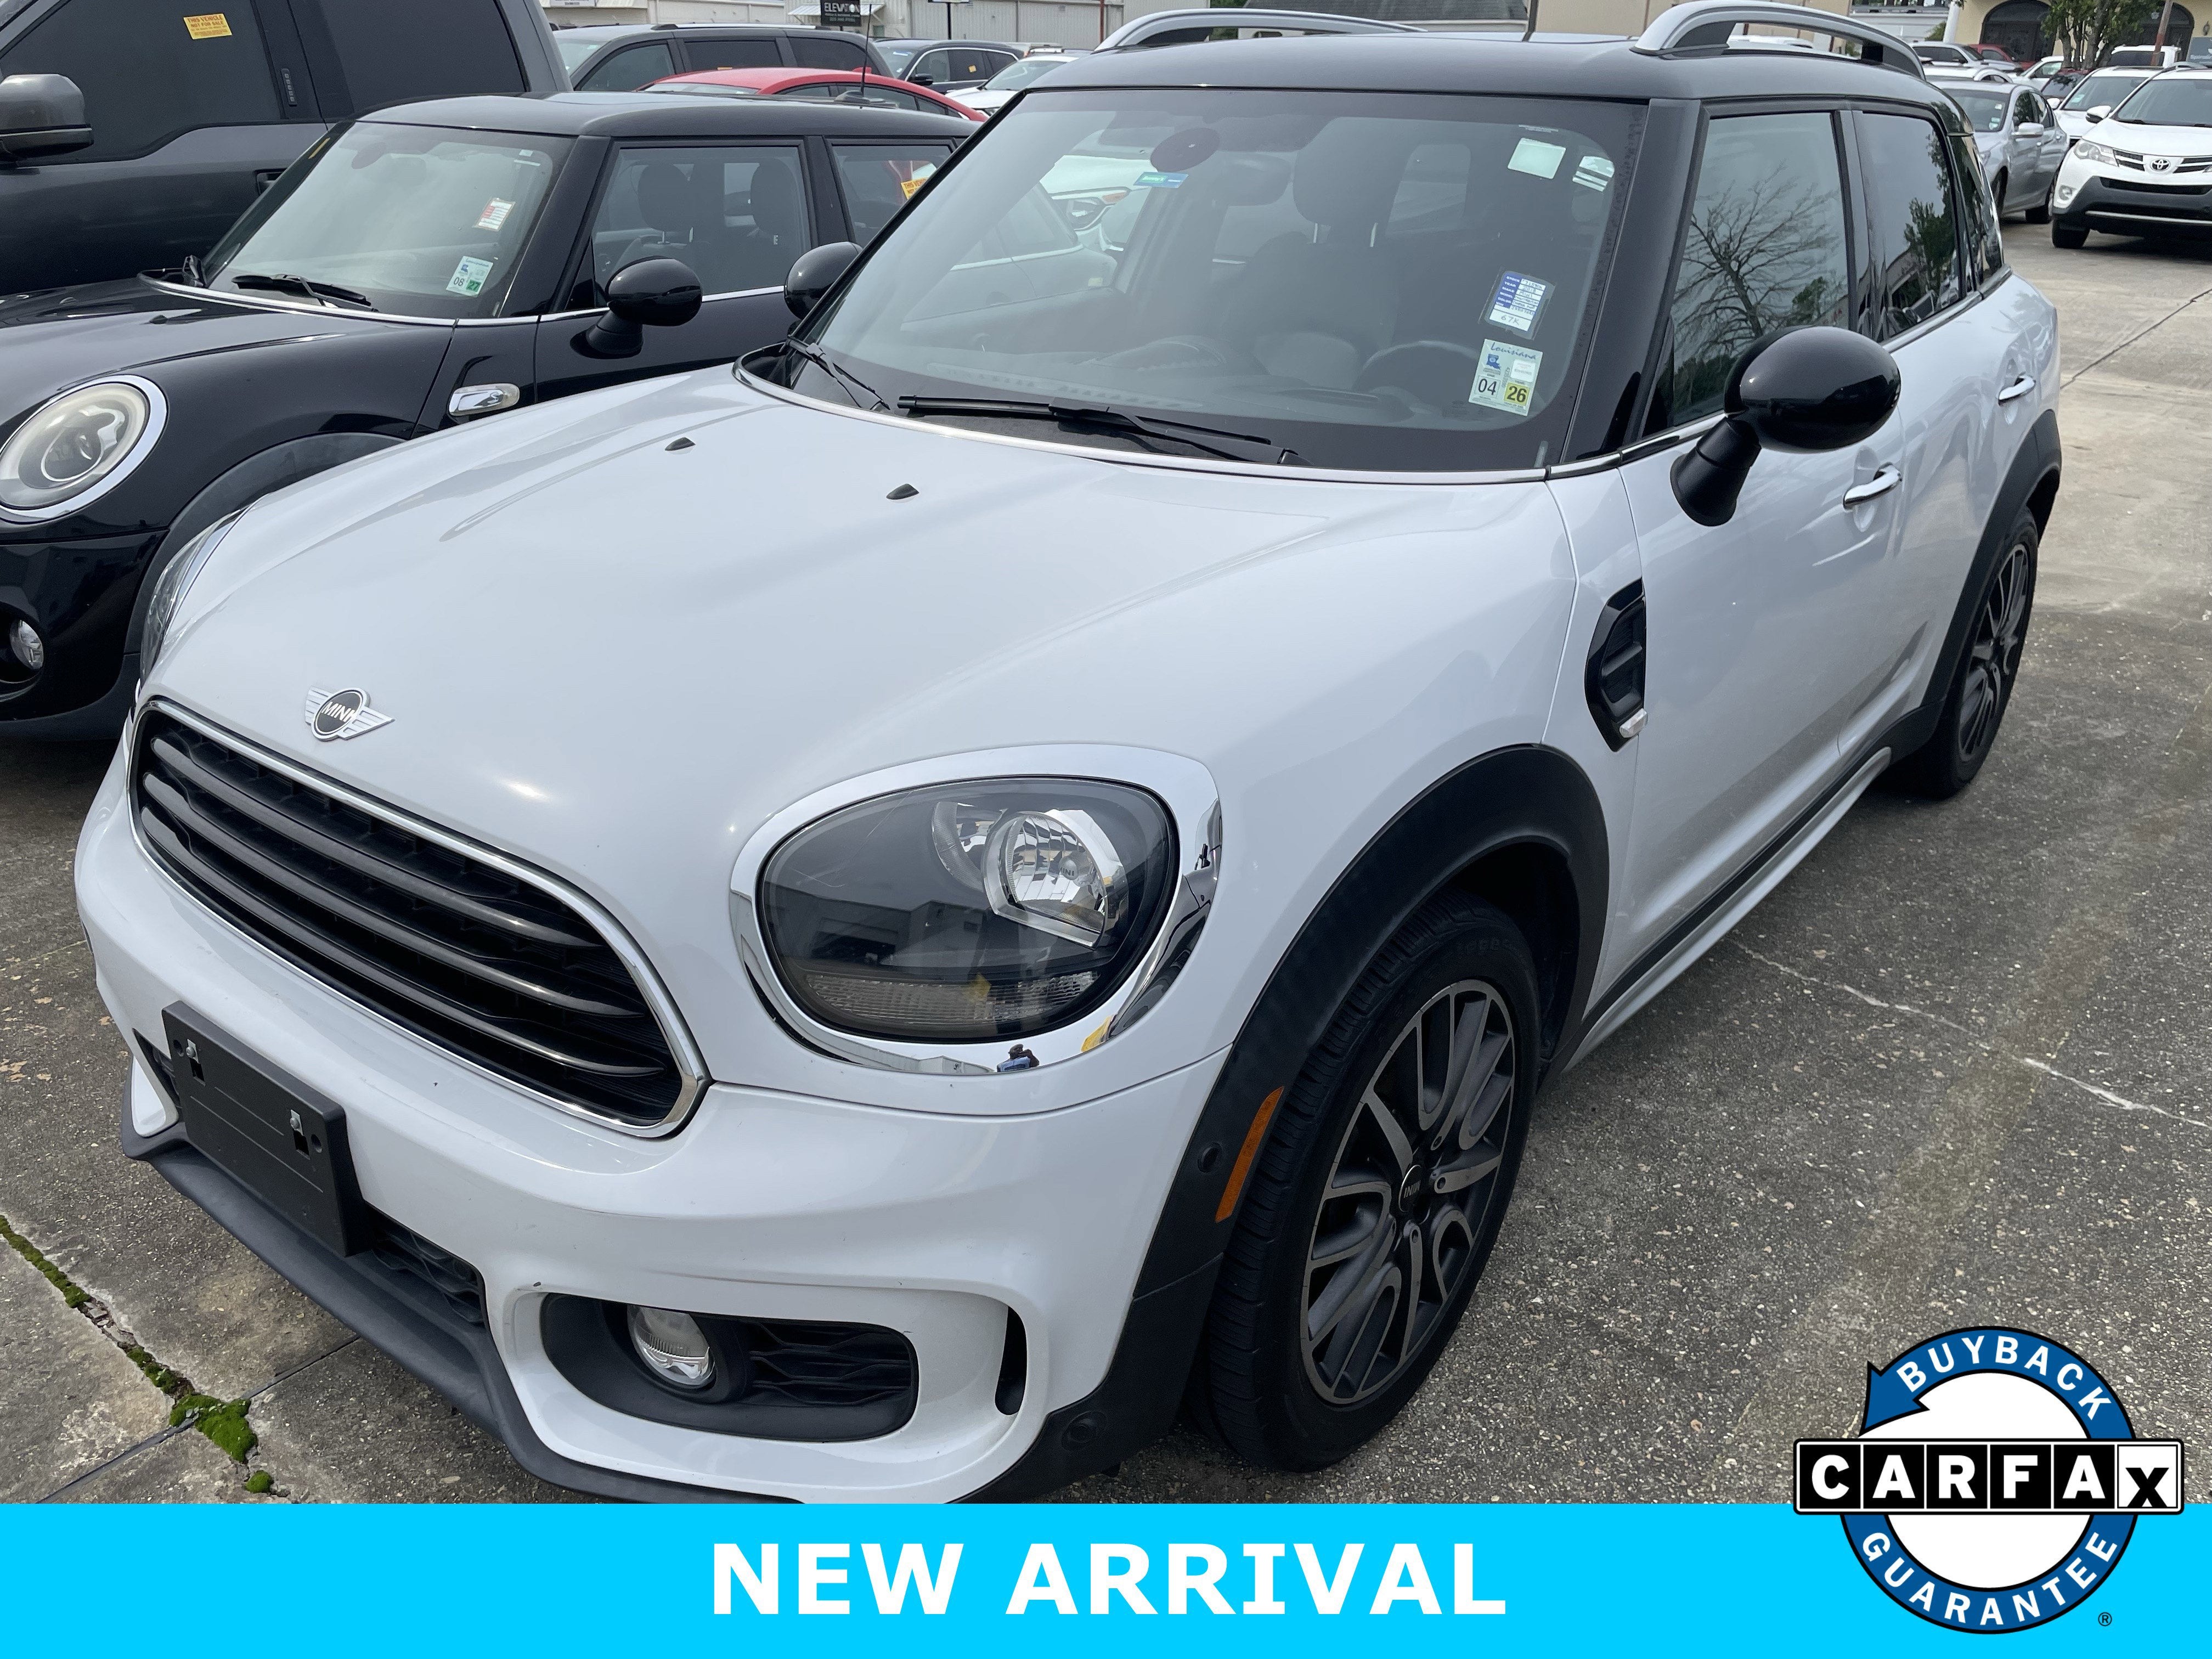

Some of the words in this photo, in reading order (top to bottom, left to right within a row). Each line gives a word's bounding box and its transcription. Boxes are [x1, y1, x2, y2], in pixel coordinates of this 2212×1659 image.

[453, 276, 465, 286] 08
[467, 280, 482, 291] 27
[1491, 342, 1536, 360] Louisiana
[1477, 378, 1497, 396] 04
[1506, 386, 1527, 403] 26
[321, 701, 358, 723] MINI
